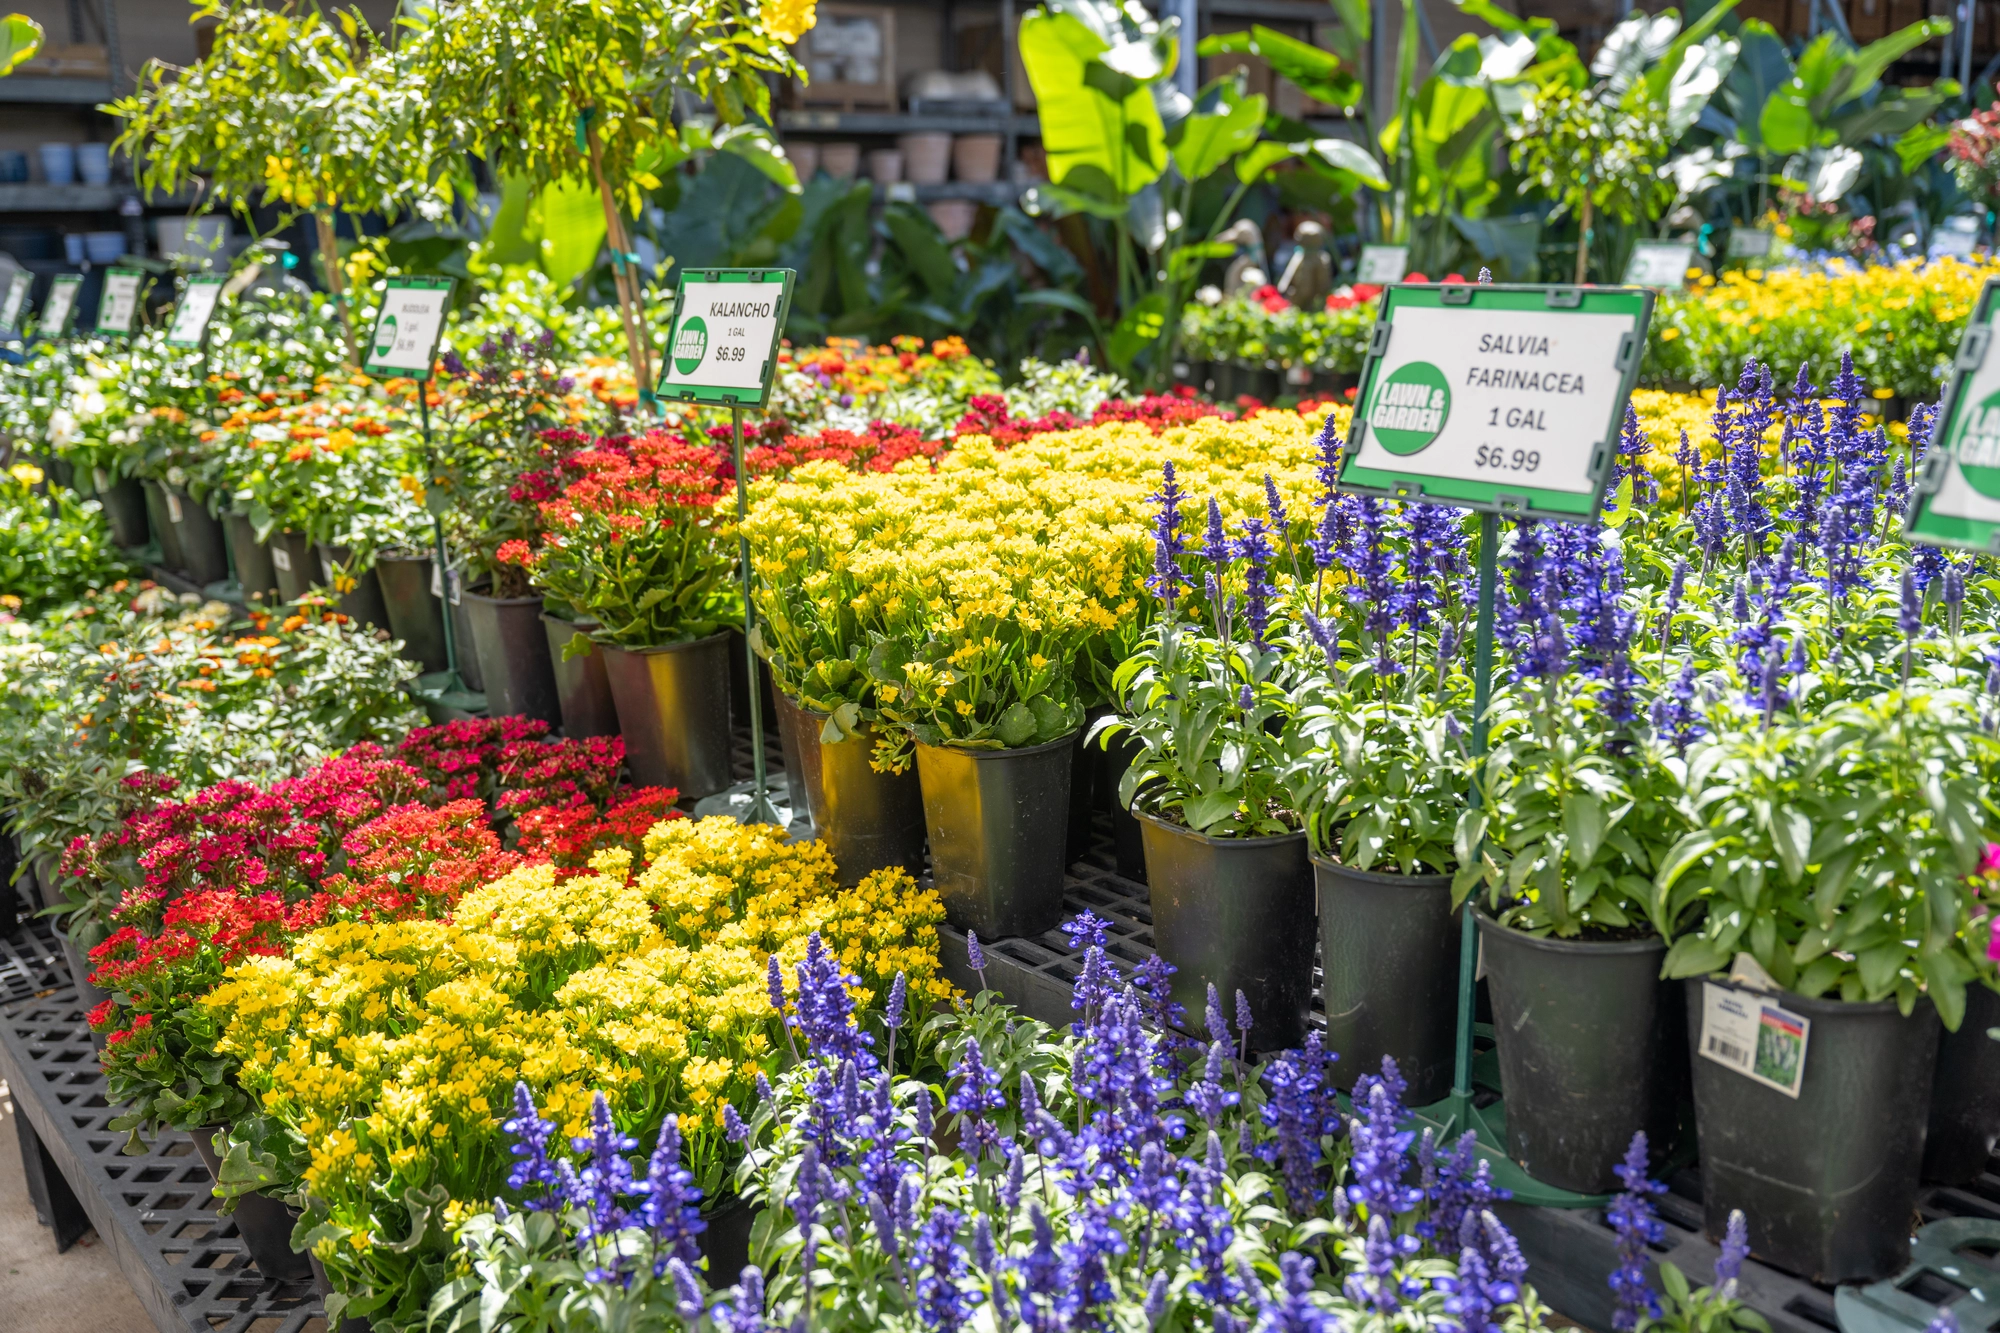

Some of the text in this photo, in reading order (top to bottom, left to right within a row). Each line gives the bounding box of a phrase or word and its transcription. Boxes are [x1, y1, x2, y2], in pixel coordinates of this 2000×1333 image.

[710, 302, 770, 318] KALANCHO
[678, 330, 705, 344] LAWN &
[728, 327, 745, 336] 1 GAL
[675, 343, 704, 359] GARDEN
[716, 345, 745, 362] $6.99
[1478, 333, 1549, 356] SALVIA
[1466, 367, 1584, 394] FARINACEA
[1379, 382, 1445, 409] LAWN &
[1373, 406, 1443, 433] GARDEN
[1488, 407, 1547, 431] 1 GAL
[1474, 443, 1541, 472] $6.99
